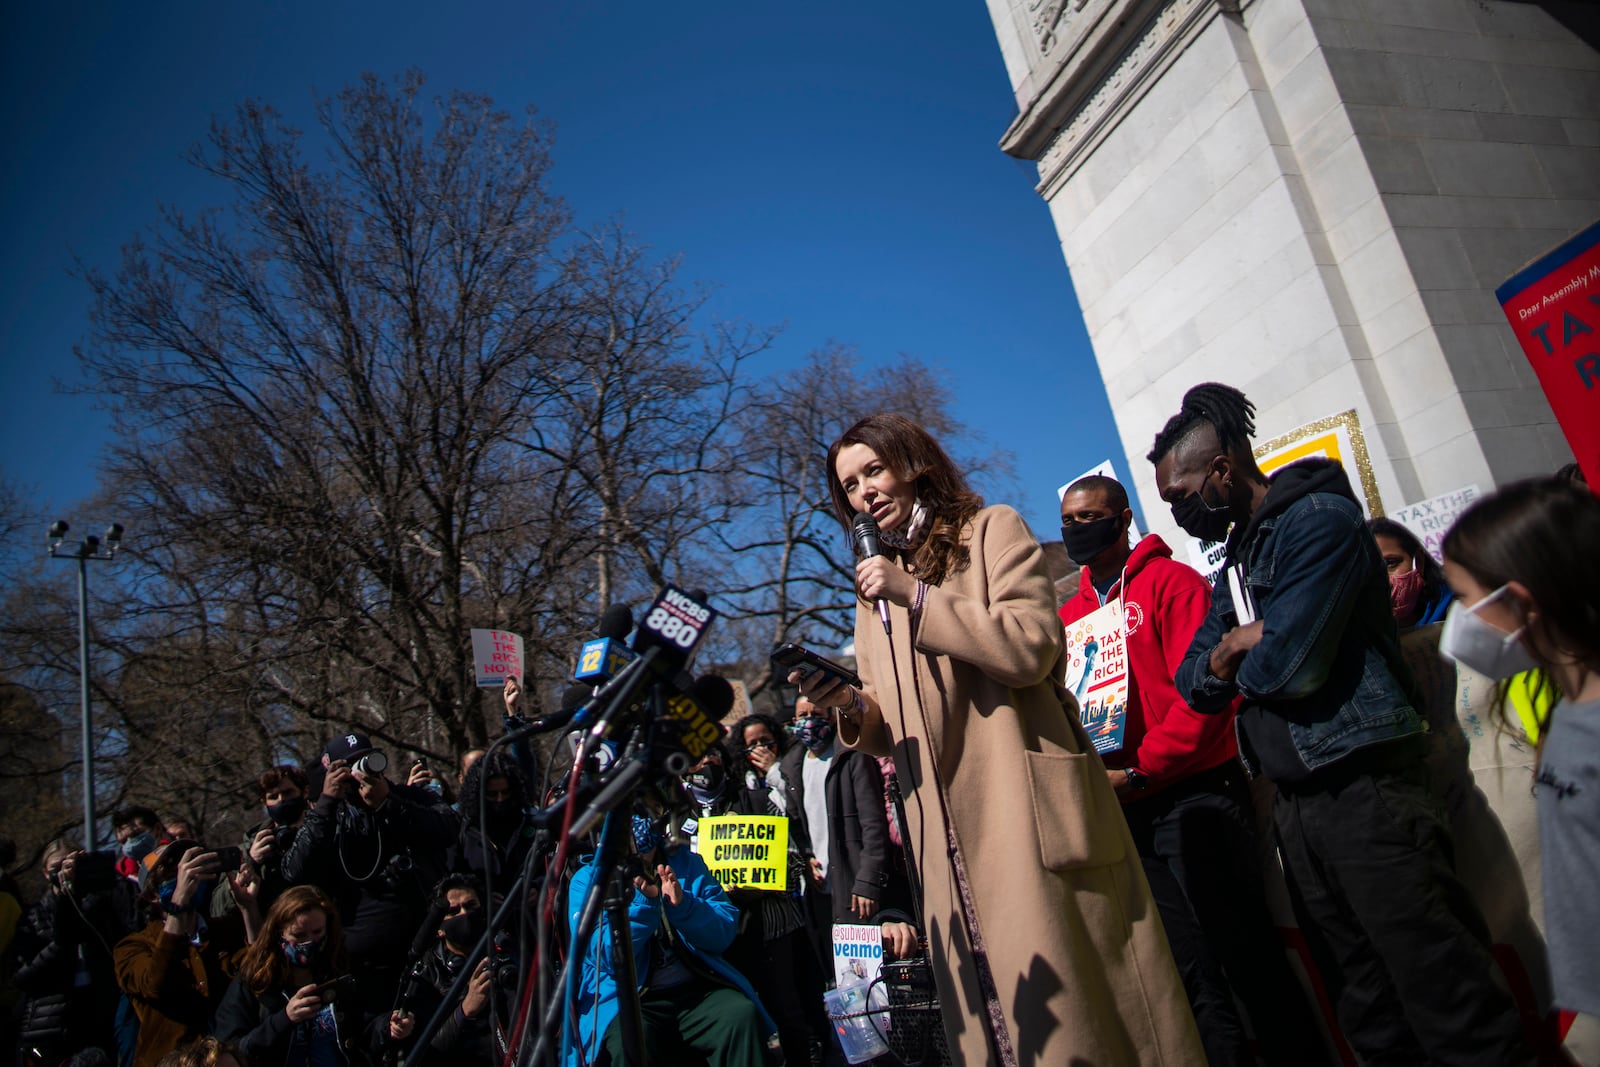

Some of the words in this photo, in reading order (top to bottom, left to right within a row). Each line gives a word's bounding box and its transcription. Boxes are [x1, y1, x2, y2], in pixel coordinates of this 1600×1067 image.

[1519, 302, 1540, 319] Dear
[1542, 275, 1588, 306] Assembly
[1530, 294, 1600, 355] TA
[1397, 502, 1435, 523] TAX
[1437, 489, 1475, 510] THE
[665, 589, 711, 623] WCBS
[646, 607, 699, 648] 880
[1100, 628, 1121, 648] TAX
[581, 650, 602, 673] 12
[1101, 643, 1123, 663] THE
[1095, 658, 1124, 681] RICH
[711, 823, 775, 840] IMPEACH
[714, 844, 769, 861] CUOMO!
[711, 868, 748, 884] OUSE
[751, 867, 776, 884] NY!
[834, 943, 882, 959] venmo
